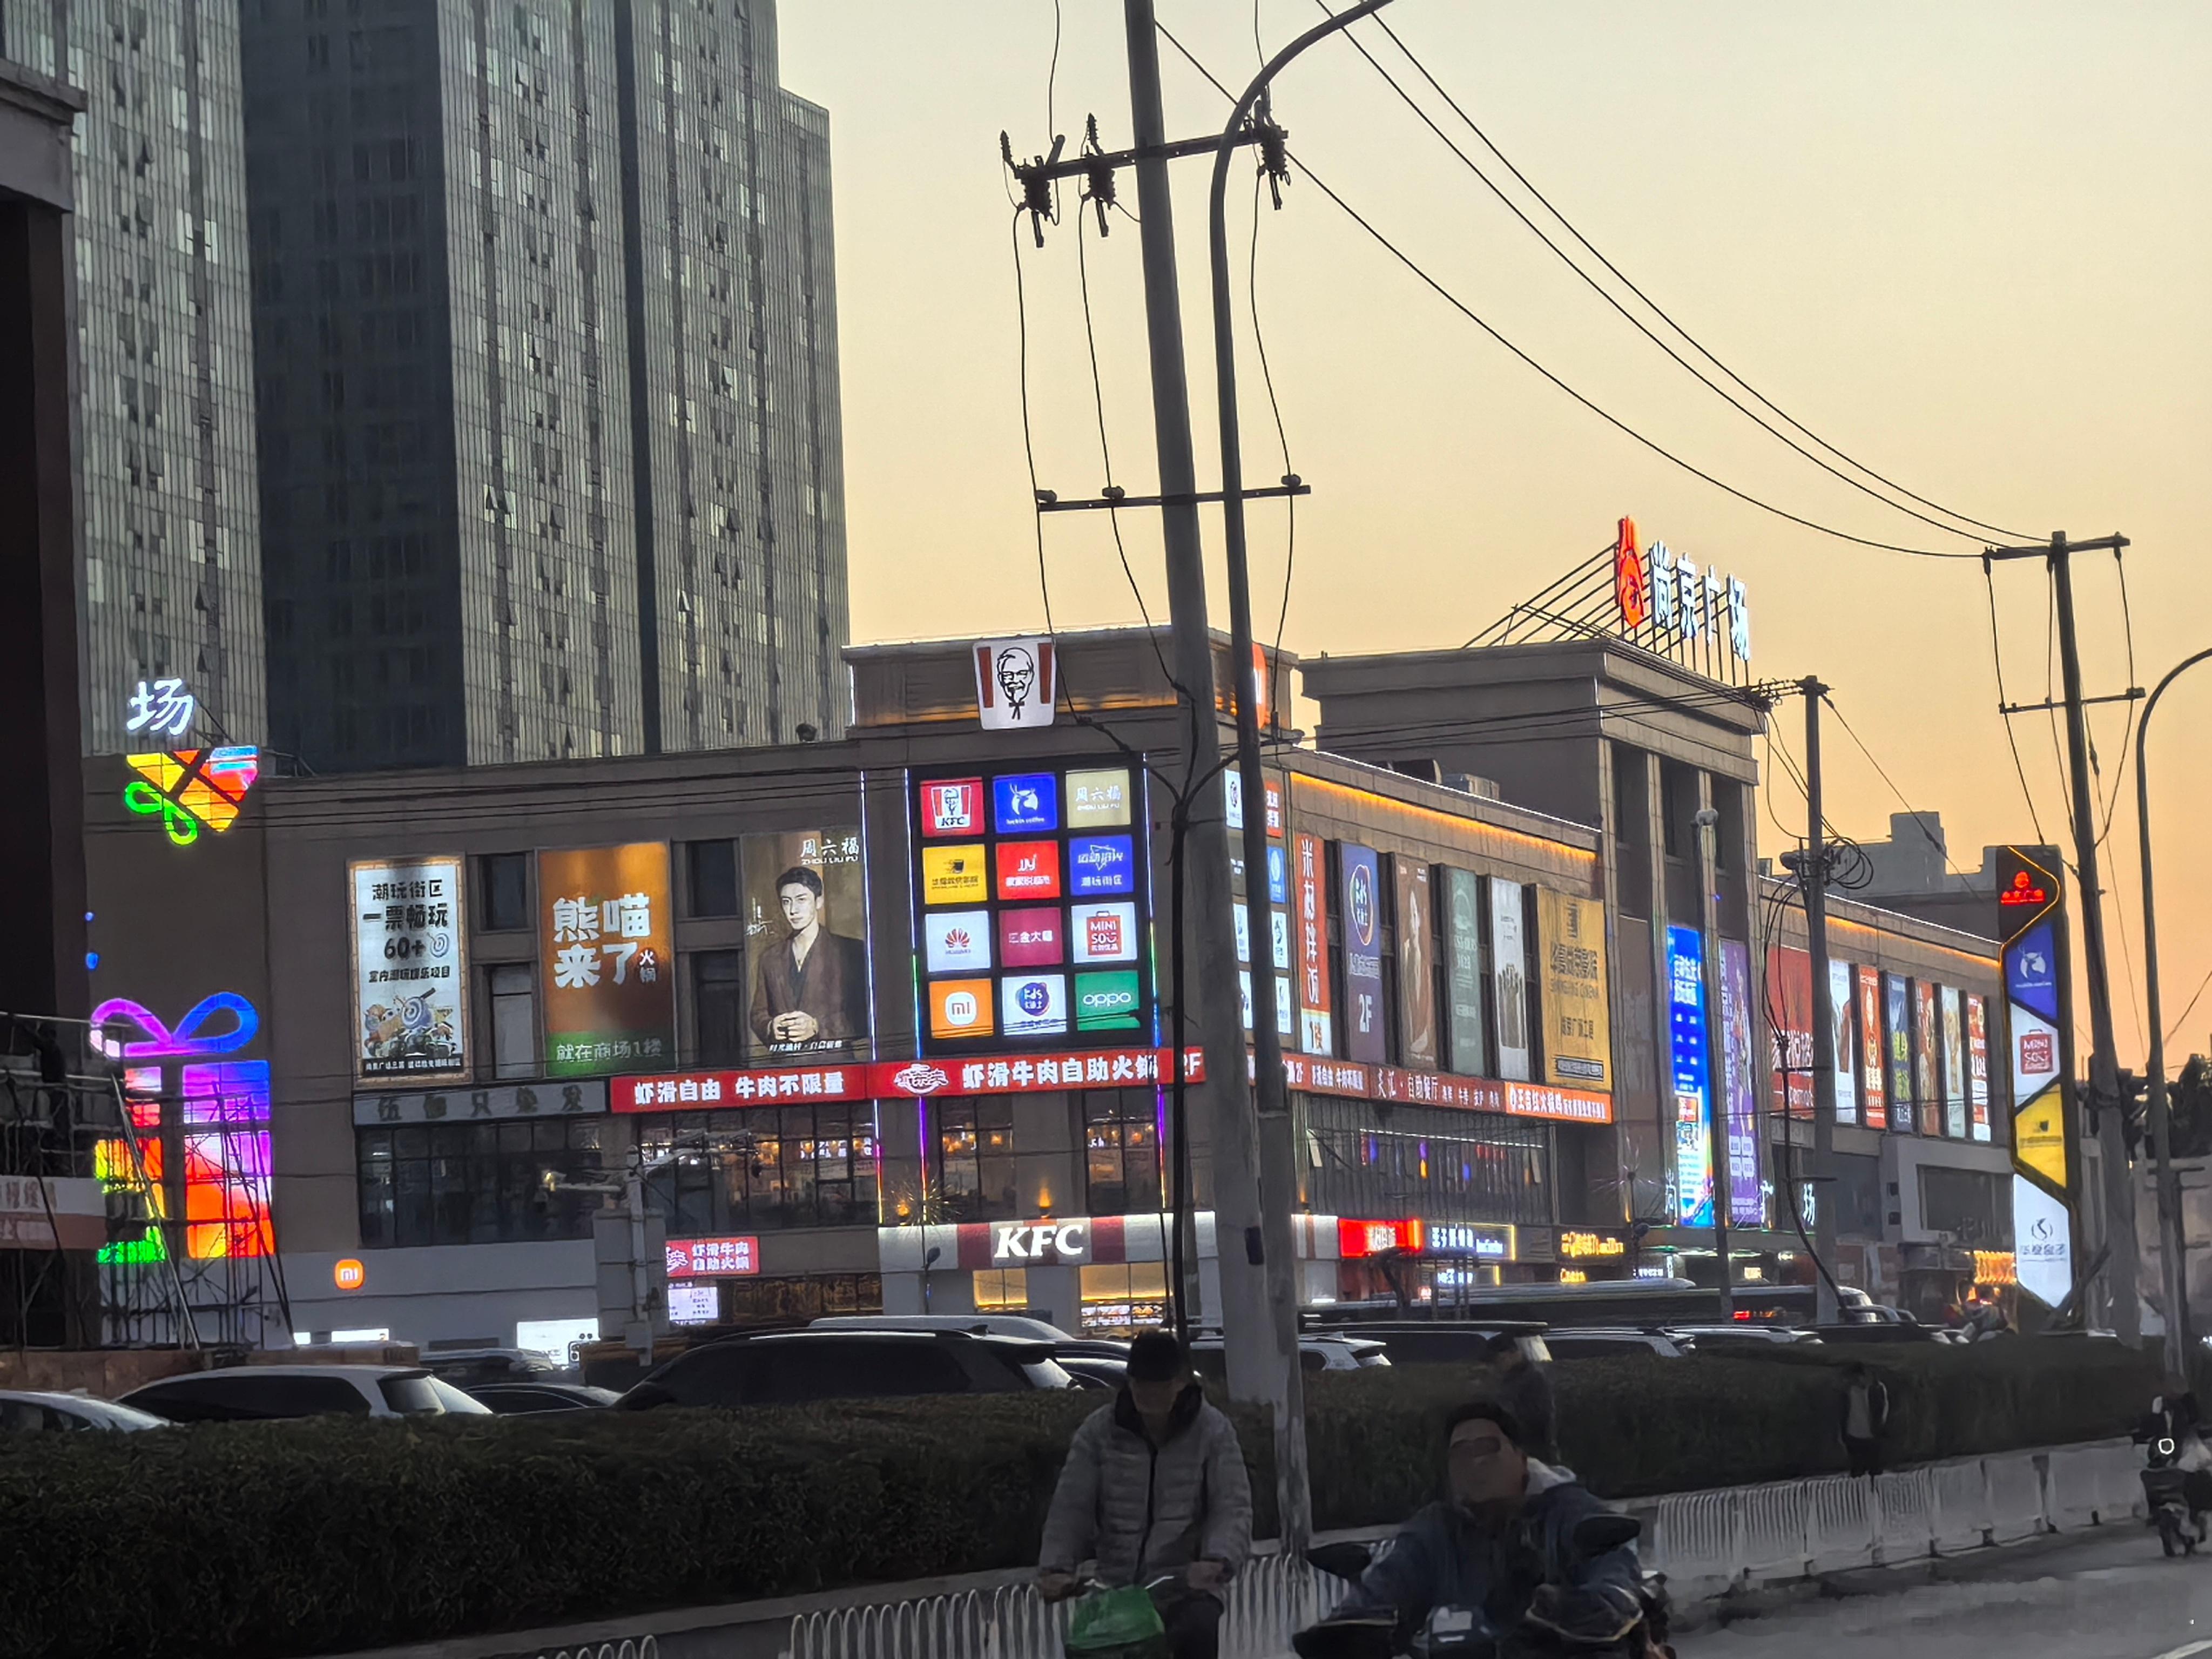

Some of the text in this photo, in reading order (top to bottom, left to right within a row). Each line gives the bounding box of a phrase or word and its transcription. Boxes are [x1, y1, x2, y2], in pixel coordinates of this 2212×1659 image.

[126, 677, 194, 736] 场
[941, 816, 965, 826] KFC
[800, 837, 859, 858] 周六福
[372, 879, 443, 901] 潮玩街区
[363, 903, 448, 931] 一票畅玩
[552, 893, 651, 942] 熊喵
[1090, 920, 1117, 931] MINI
[384, 937, 426, 960] 60+
[554, 942, 638, 988] 来了
[1358, 993, 1372, 1033] 2F
[962, 1054, 1159, 1089] 虾滑牛肉自助火锅
[634, 1071, 844, 1105] 虾滑自由 牛肉不限量
[692, 1241, 750, 1257] 虾滑牛肉
[994, 1224, 1084, 1258] KFC
[692, 1255, 750, 1271] 自助火锅
